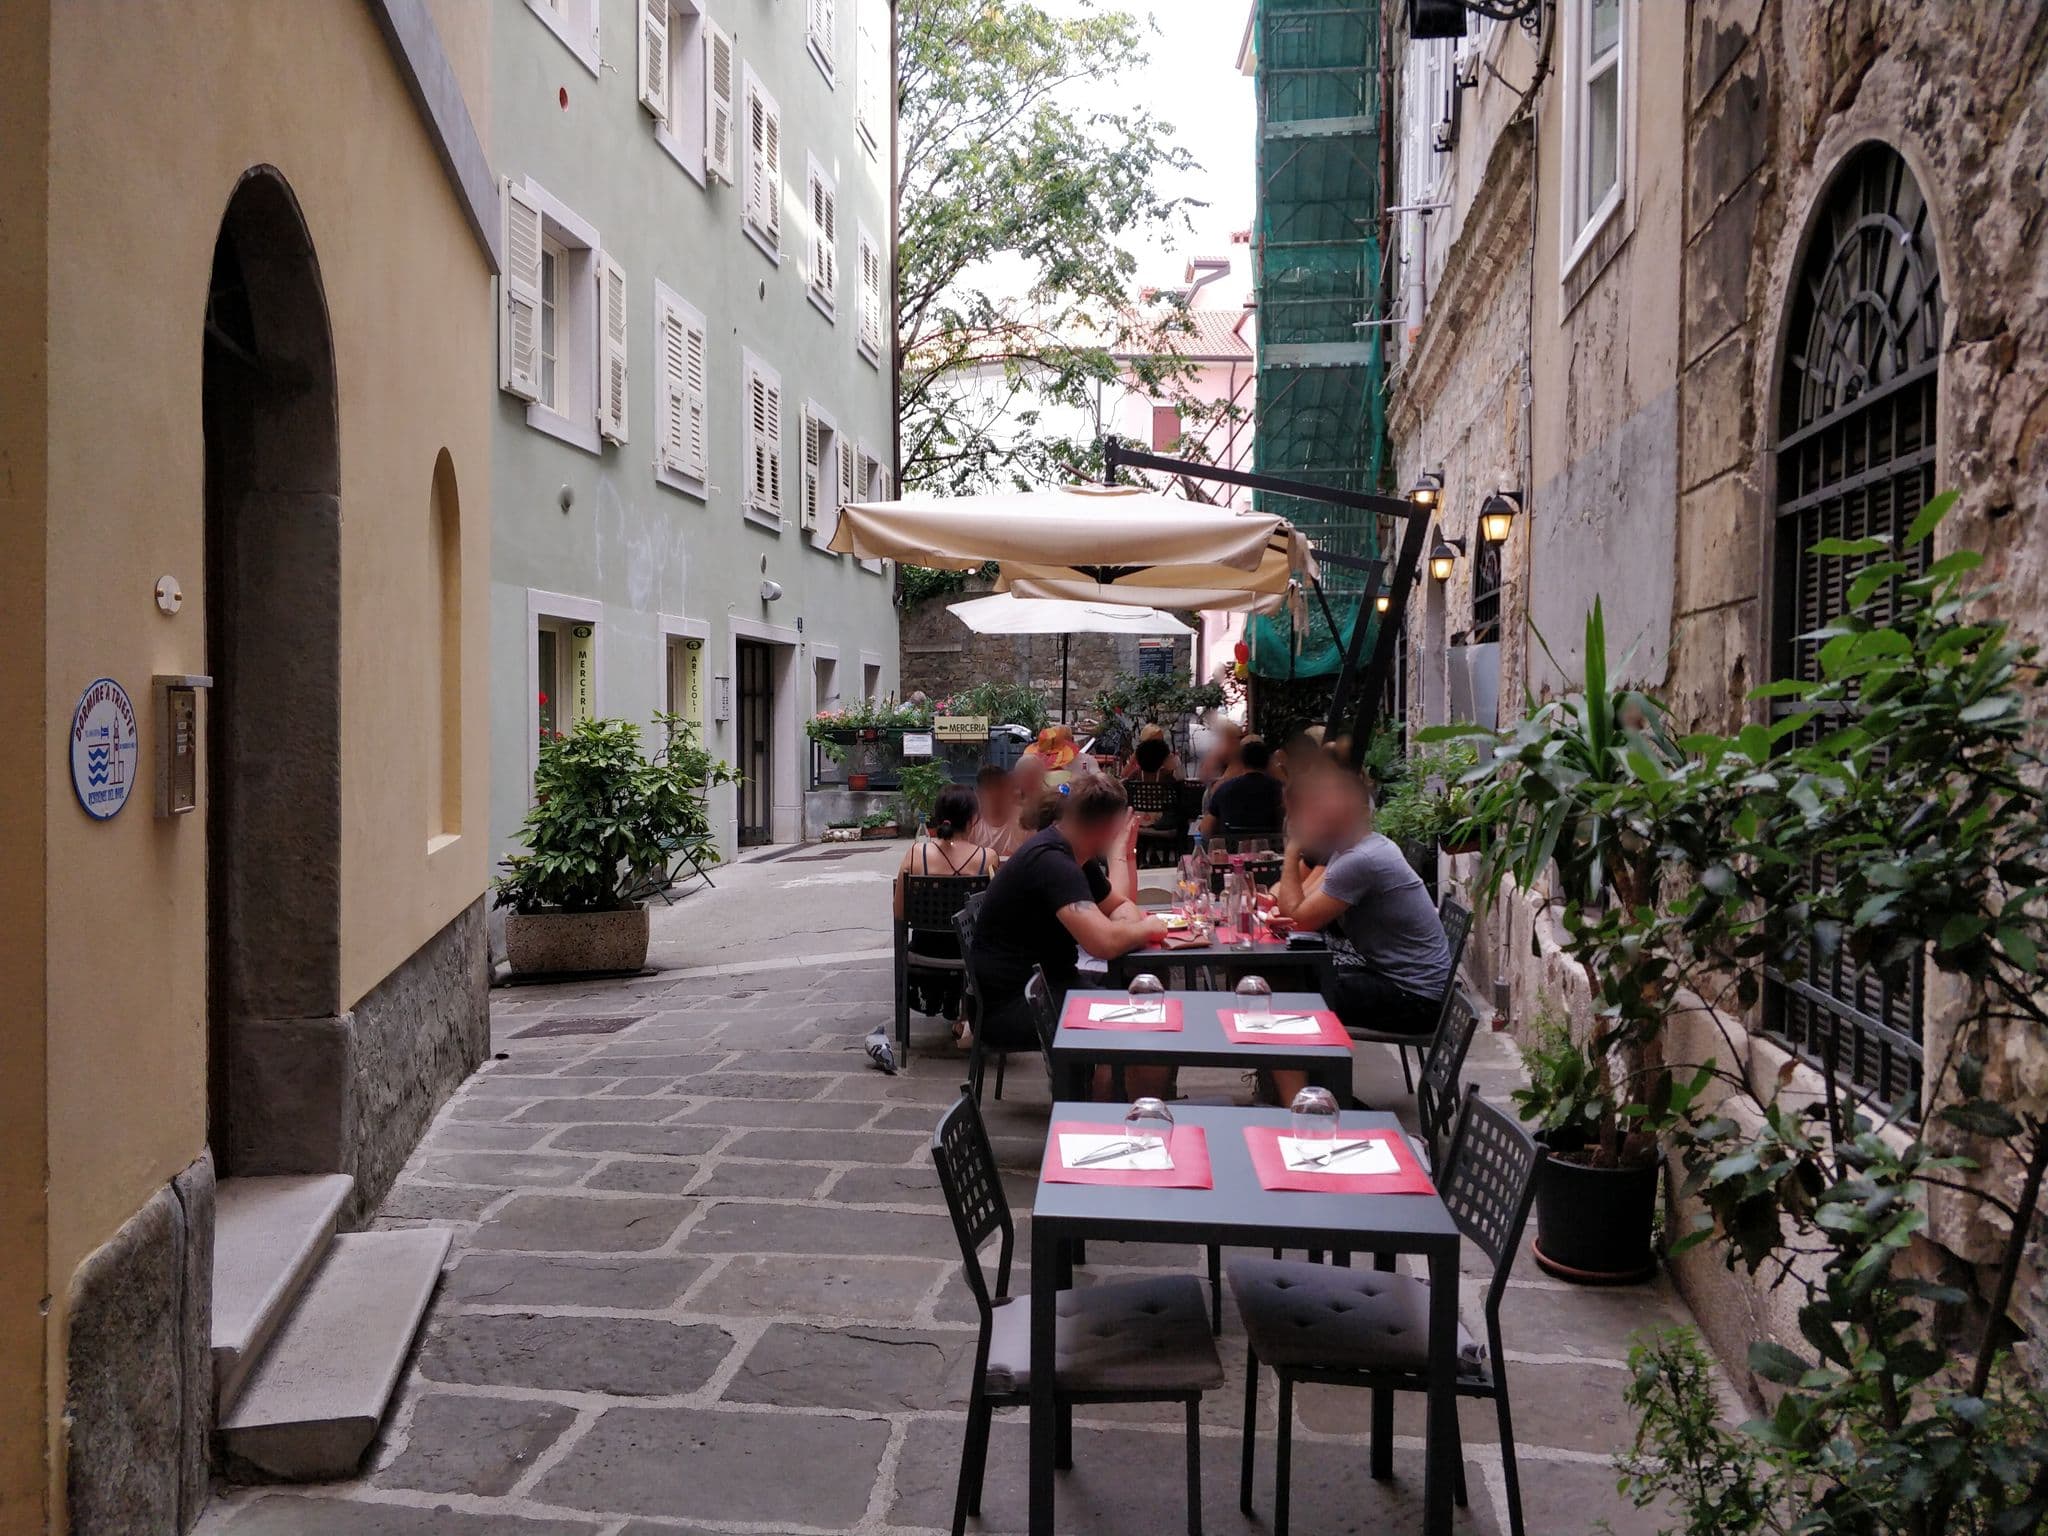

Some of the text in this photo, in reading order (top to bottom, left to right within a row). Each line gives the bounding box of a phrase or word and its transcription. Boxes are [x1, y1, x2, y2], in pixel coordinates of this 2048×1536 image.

[75, 685, 135, 742] DORMIRE A TRIESTE
[578, 651, 587, 722] MERCERIA
[949, 723, 986, 732] MERCERIA
